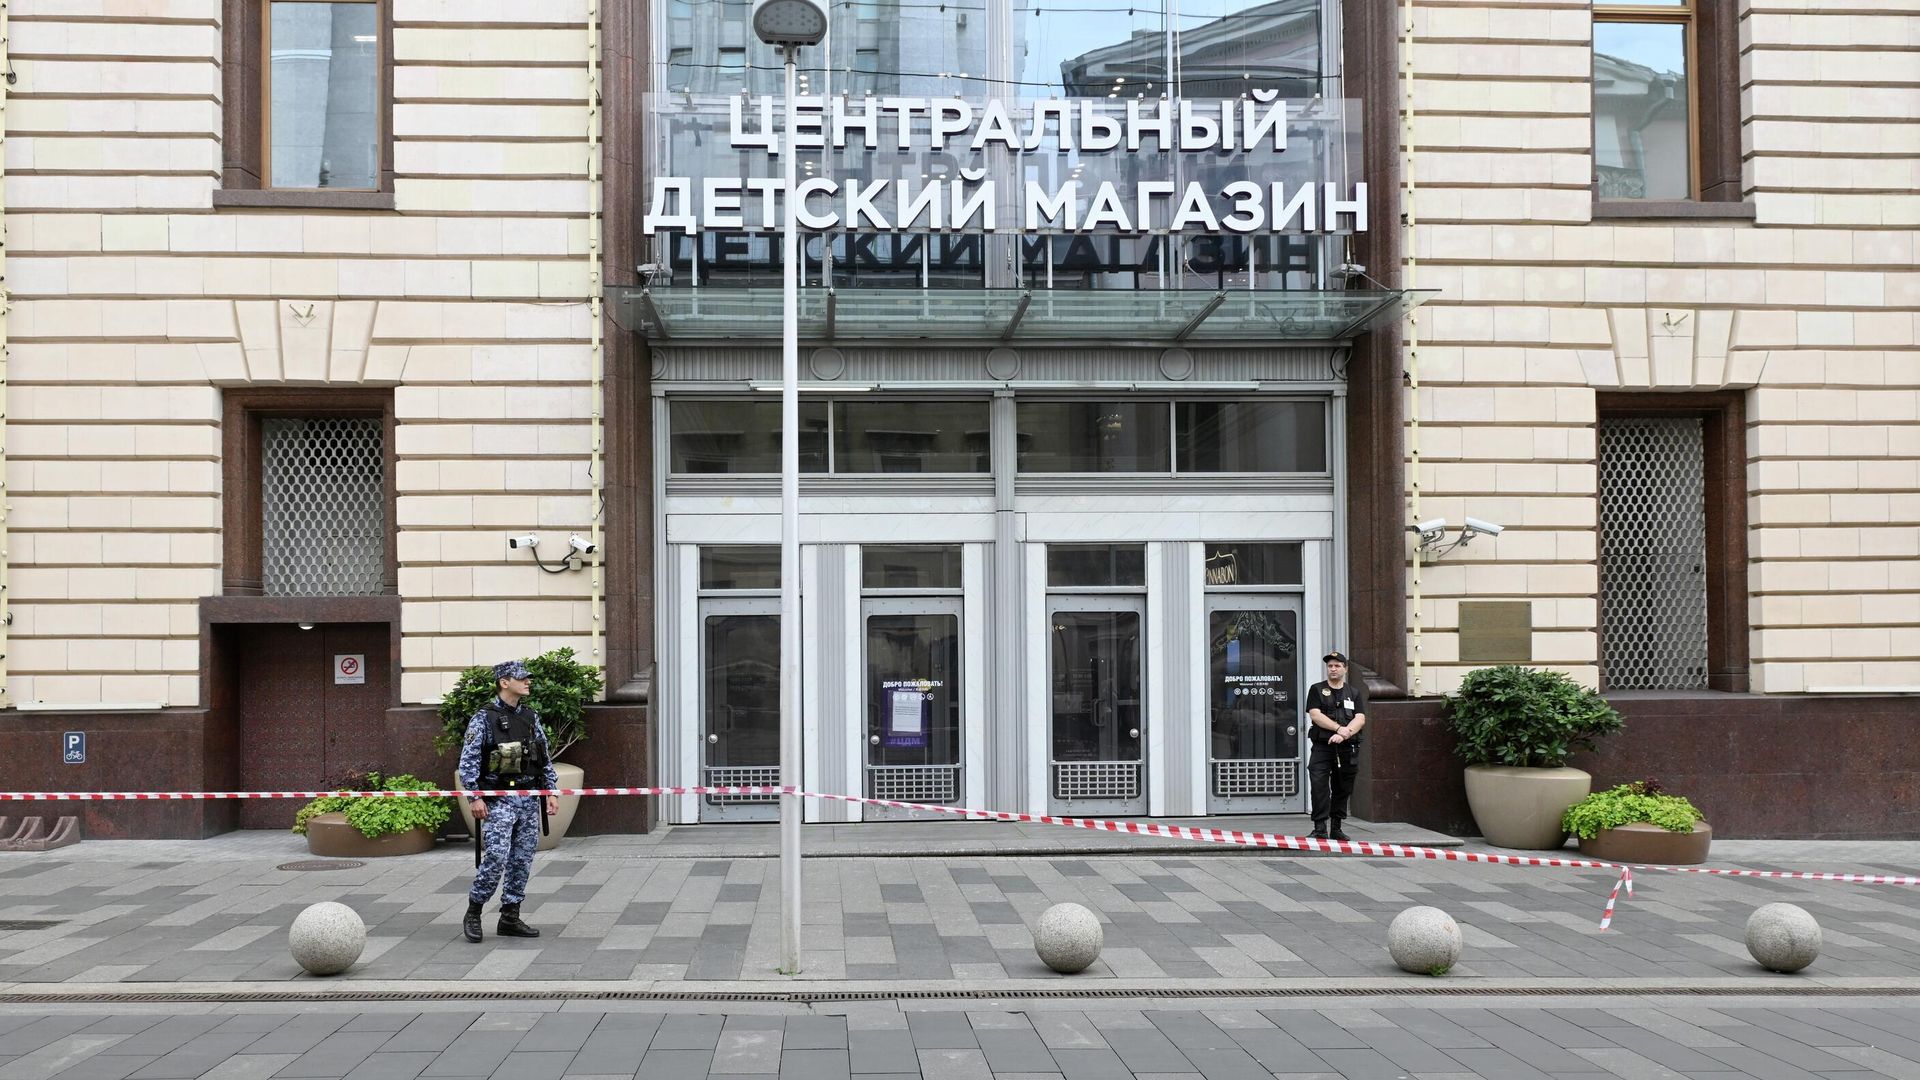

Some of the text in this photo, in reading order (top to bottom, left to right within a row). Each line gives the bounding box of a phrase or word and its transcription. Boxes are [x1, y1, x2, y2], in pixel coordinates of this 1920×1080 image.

[729, 89, 1287, 156] ЦЕНТРАЛЬНЫЙ
[643, 168, 1368, 236] ДЕТСКИЙ МАГАЗИН
[69, 735, 80, 749] P
